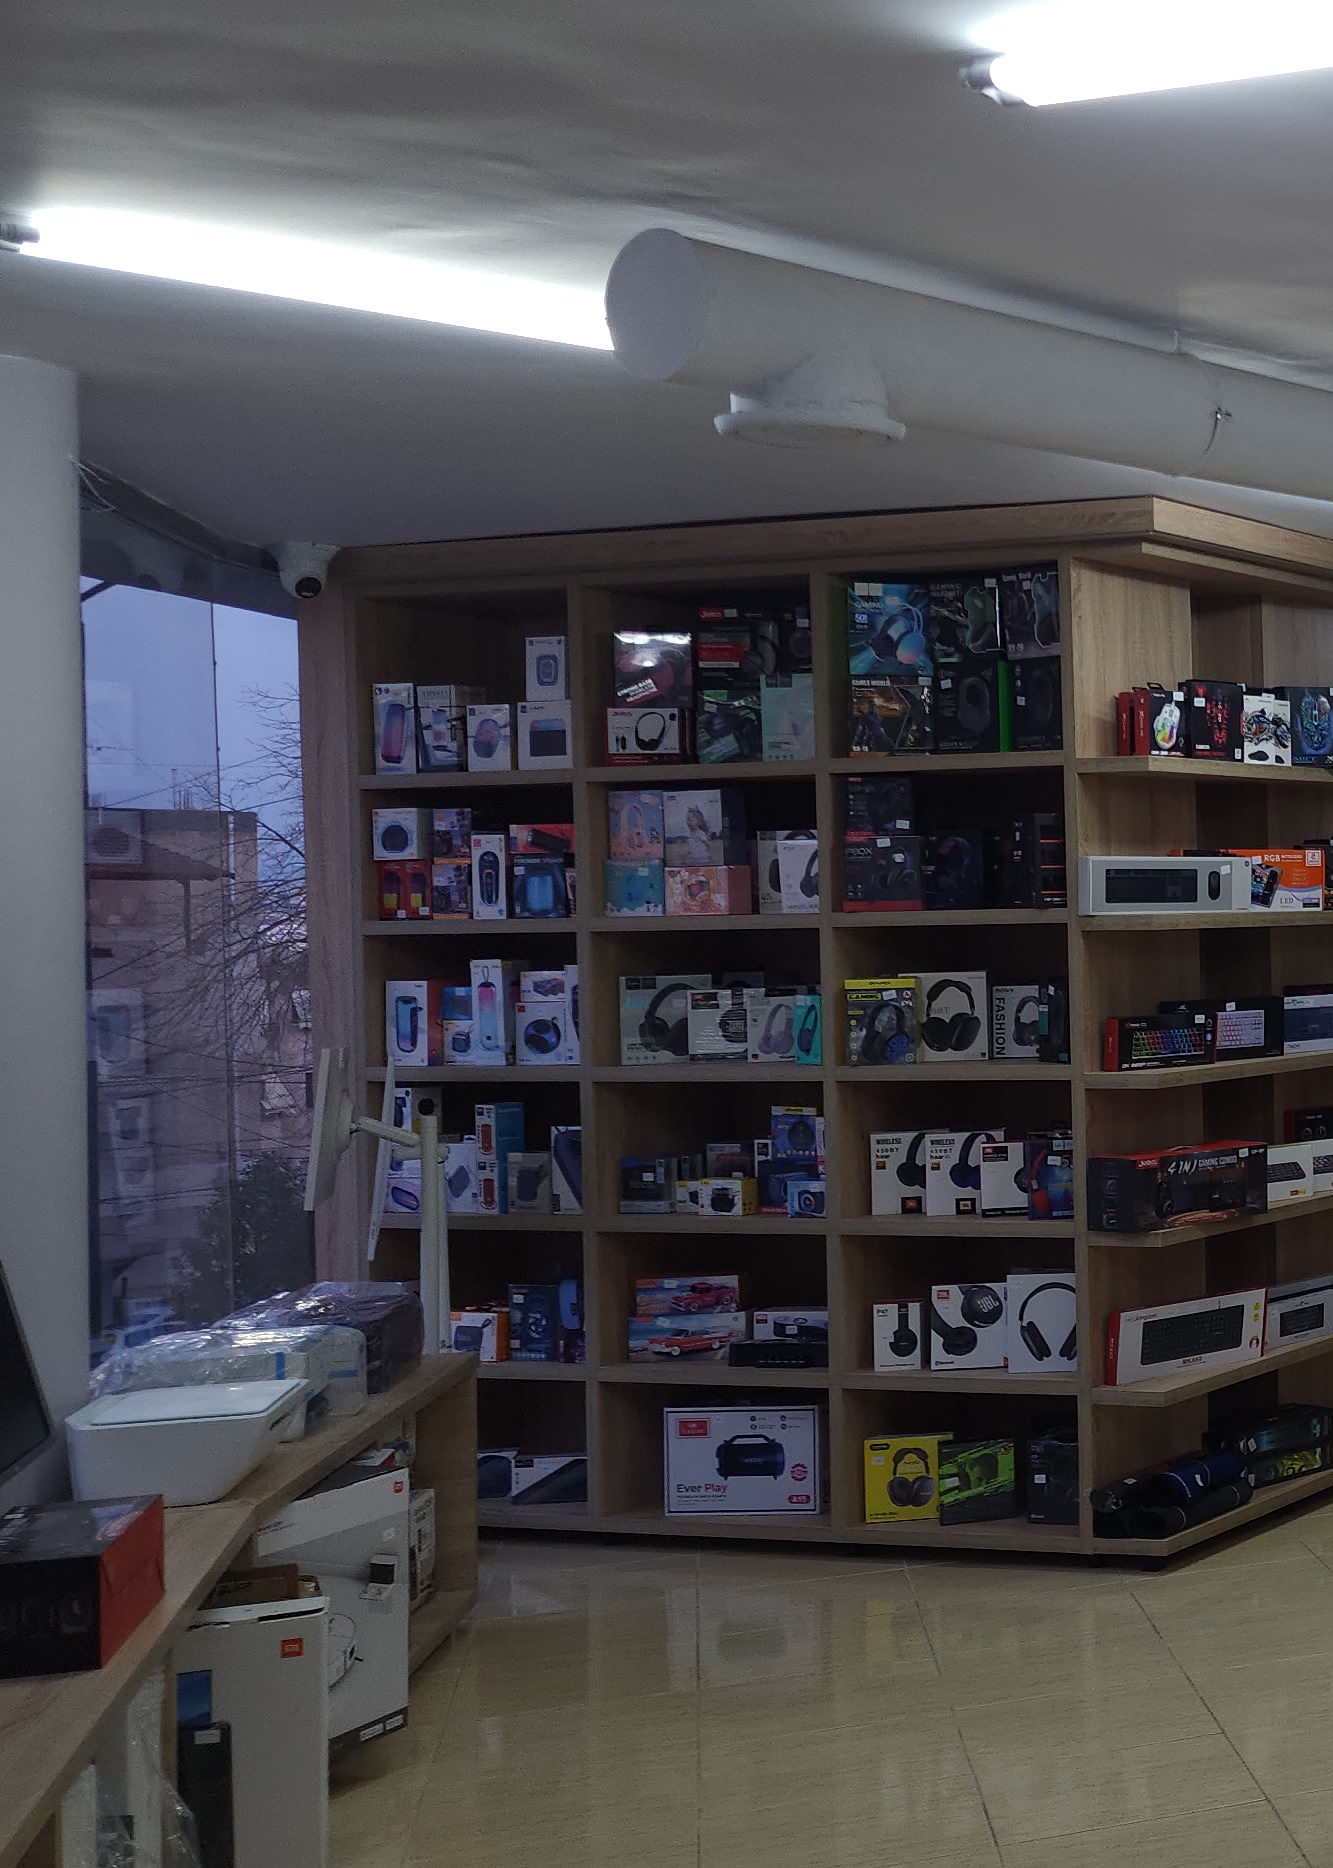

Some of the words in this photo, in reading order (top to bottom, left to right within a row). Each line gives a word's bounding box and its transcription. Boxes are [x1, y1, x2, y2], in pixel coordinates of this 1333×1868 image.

[1264, 854, 1281, 863] RGB
[995, 996, 1006, 1056] FASHION
[976, 1295, 1000, 1313] JBL
[676, 1483, 702, 1493] Ever
[704, 1483, 728, 1495] Play
